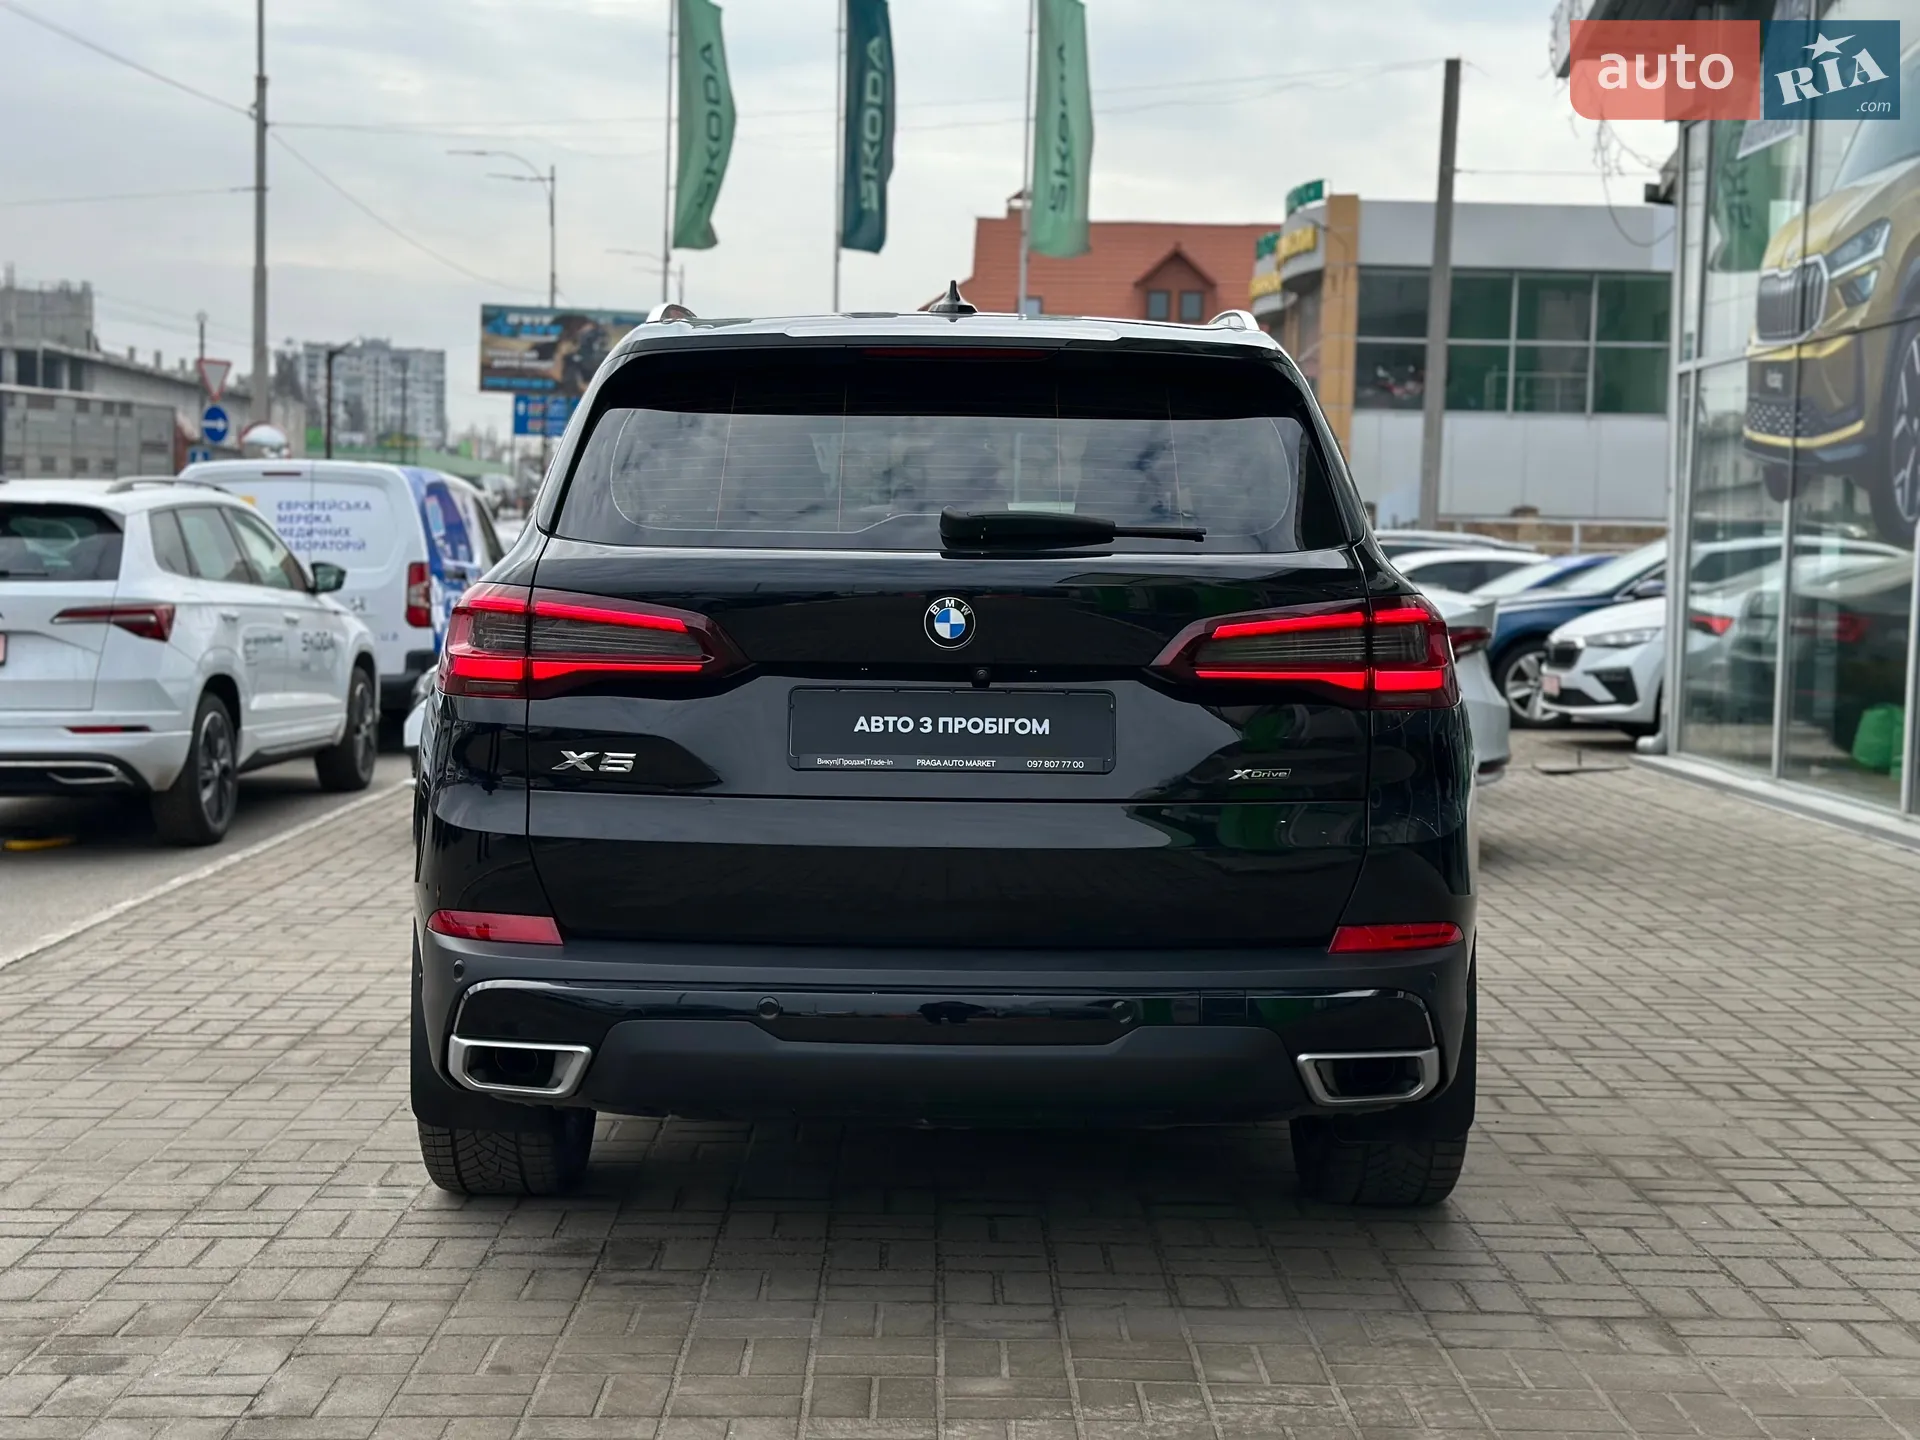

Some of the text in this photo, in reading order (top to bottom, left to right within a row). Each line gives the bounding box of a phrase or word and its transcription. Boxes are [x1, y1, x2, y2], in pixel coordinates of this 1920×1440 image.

[277, 500, 372, 511] ЄВРОПЕЙСЬКА
[277, 527, 351, 538] МЕДИЧНИХ
[287, 540, 367, 551] БОРАТОРІЙ
[930, 599, 971, 616] BMW
[853, 715, 1050, 735] АВТО З ПРОБІГОМ
[551, 750, 637, 773] X5
[916, 759, 996, 768] PRAGA AUTO MARKET
[1026, 760, 1085, 769] 097 807 77 00
